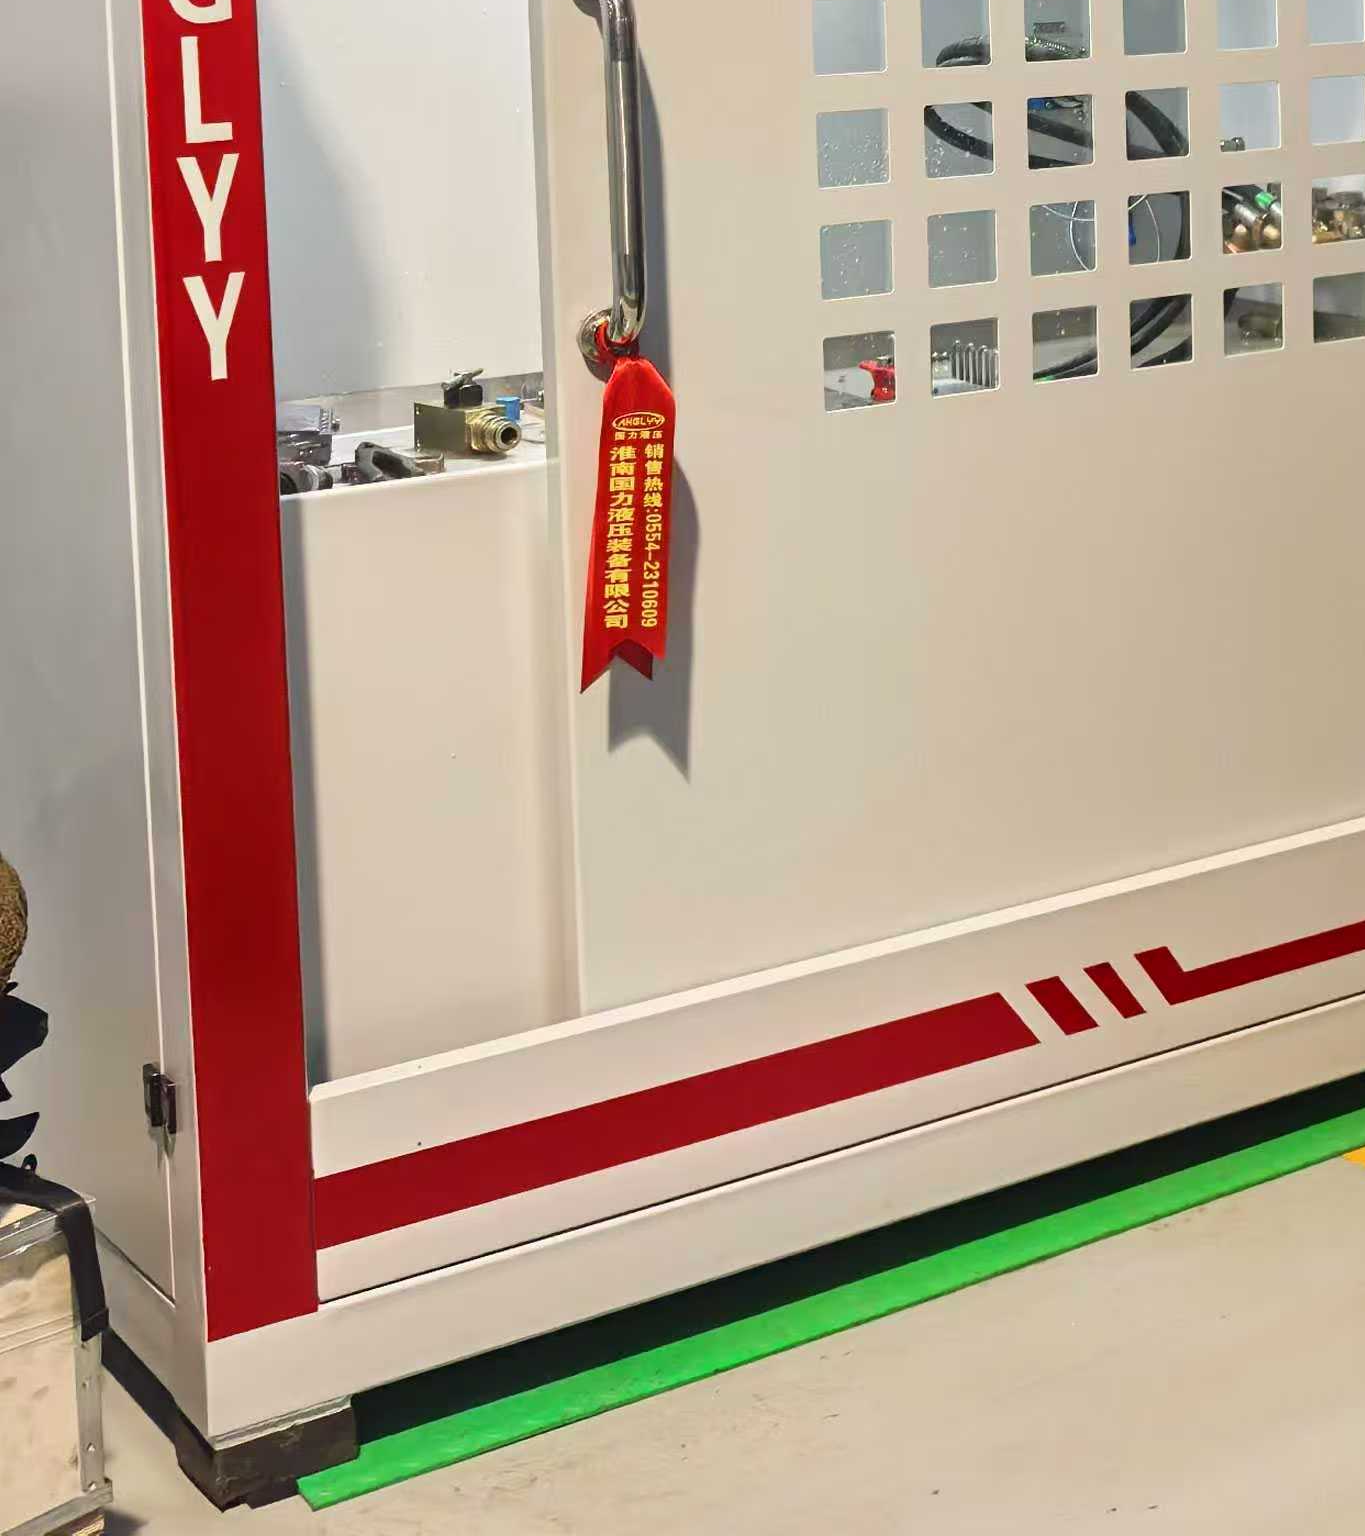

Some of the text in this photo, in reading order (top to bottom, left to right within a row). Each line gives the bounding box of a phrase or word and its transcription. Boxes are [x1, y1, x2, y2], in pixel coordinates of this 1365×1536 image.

[603, 444, 638, 629] 淮南国力液压装备有限公司
